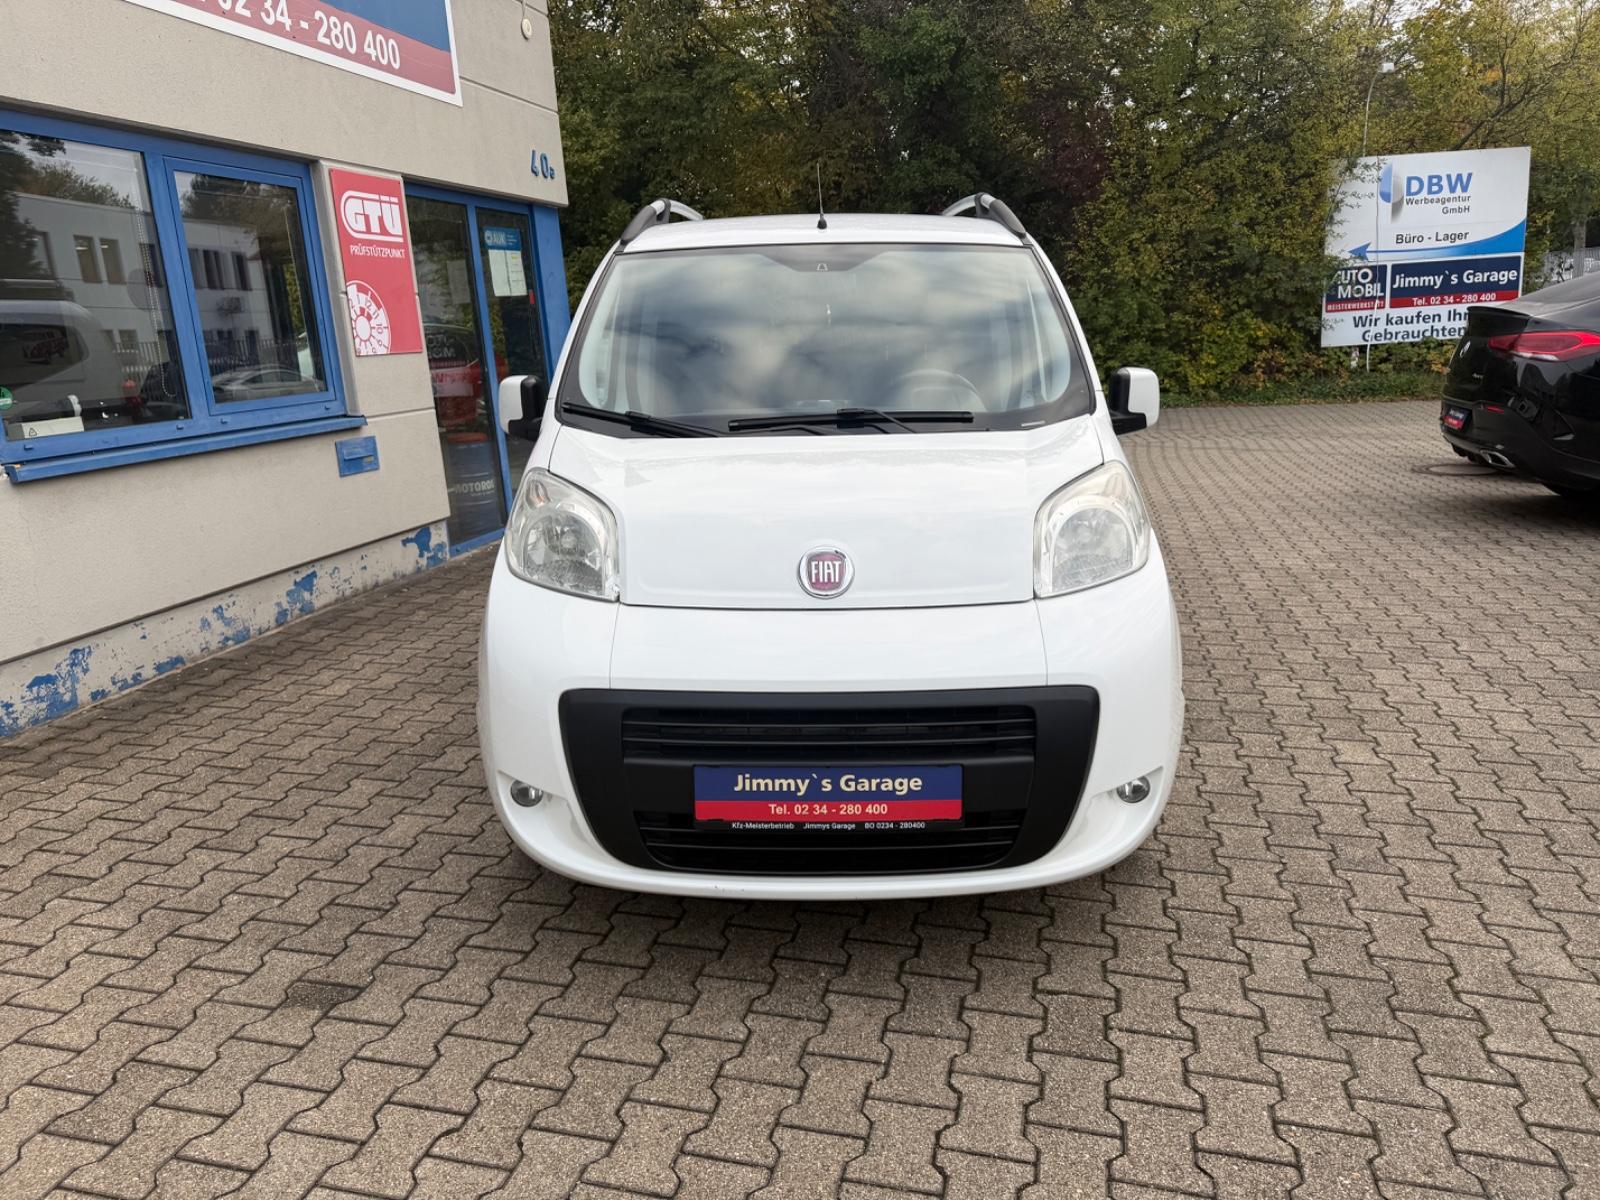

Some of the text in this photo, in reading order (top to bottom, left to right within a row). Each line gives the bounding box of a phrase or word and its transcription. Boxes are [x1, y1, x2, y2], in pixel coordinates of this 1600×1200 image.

[260, 0, 293, 32] 34
[314, 10, 357, 55] 280
[363, 29, 401, 70] 400
[1405, 172, 1473, 197] DBW
[1405, 194, 1471, 206] Werbeagentur
[342, 191, 404, 242] GTÜ
[1441, 205, 1471, 215] GmbH
[1395, 233, 1425, 245] Büro
[1435, 231, 1470, 244] Lager
[349, 244, 406, 260] PRÜFSTÜTZPUNKT
[1463, 268, 1518, 285] Garage
[1337, 283, 1384, 299] MOBIL
[1412, 297, 1428, 306] Tel.
[1430, 296, 1441, 305] 02
[1443, 295, 1454, 304] 34
[1461, 293, 1478, 303] 280
[1480, 292, 1497, 301] 400
[1353, 314, 1381, 328] Wir
[1385, 310, 1441, 327] kaufen
[811, 561, 842, 583] FIAT
[840, 774, 923, 796] Garage
[768, 803, 790, 815] Tel.
[793, 803, 809, 815] 02
[812, 803, 828, 815] 34
[839, 803, 862, 815] 280
[865, 803, 888, 815] 400
[731, 821, 795, 830] Kfz-Meisterbetrieb
[803, 821, 830, 831] Jimmys
[831, 821, 856, 830] Garage
[876, 821, 894, 829] 0234
[899, 821, 926, 829] 280400
